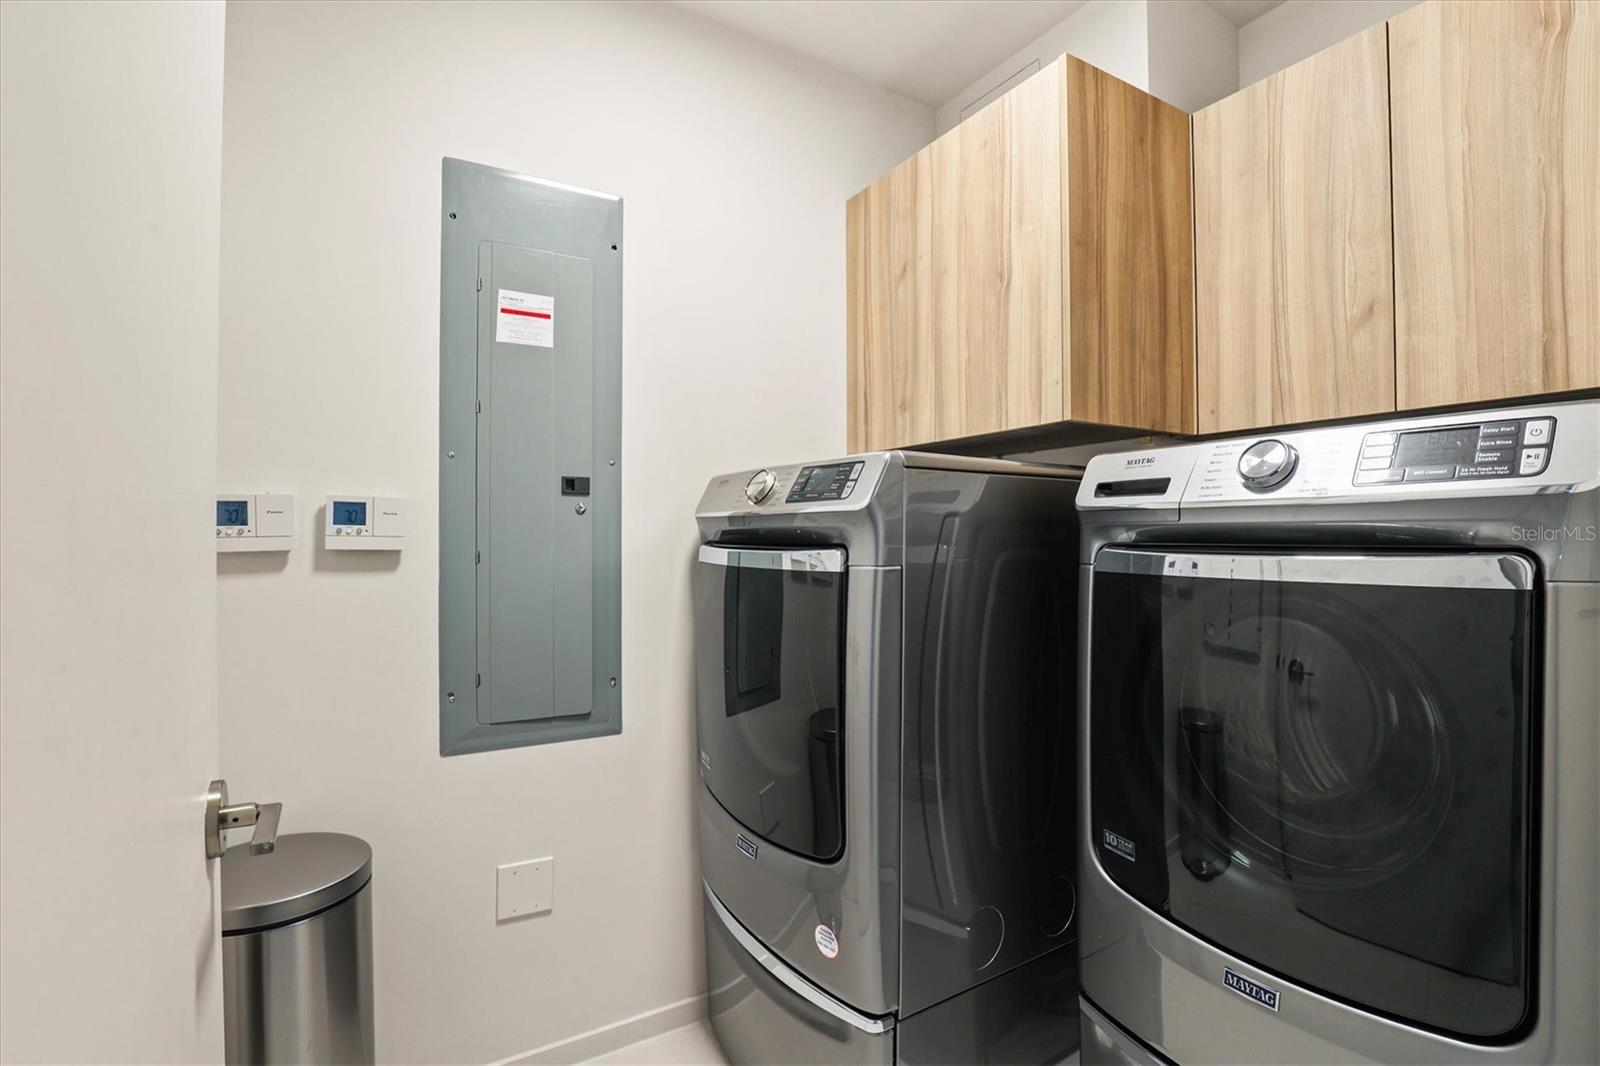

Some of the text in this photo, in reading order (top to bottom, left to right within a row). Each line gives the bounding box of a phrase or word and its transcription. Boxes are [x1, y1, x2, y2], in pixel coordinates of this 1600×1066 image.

[1126, 457, 1155, 466] MAYTAG
[1105, 831, 1117, 847] 10
[1226, 972, 1275, 1005] MAYTAG
